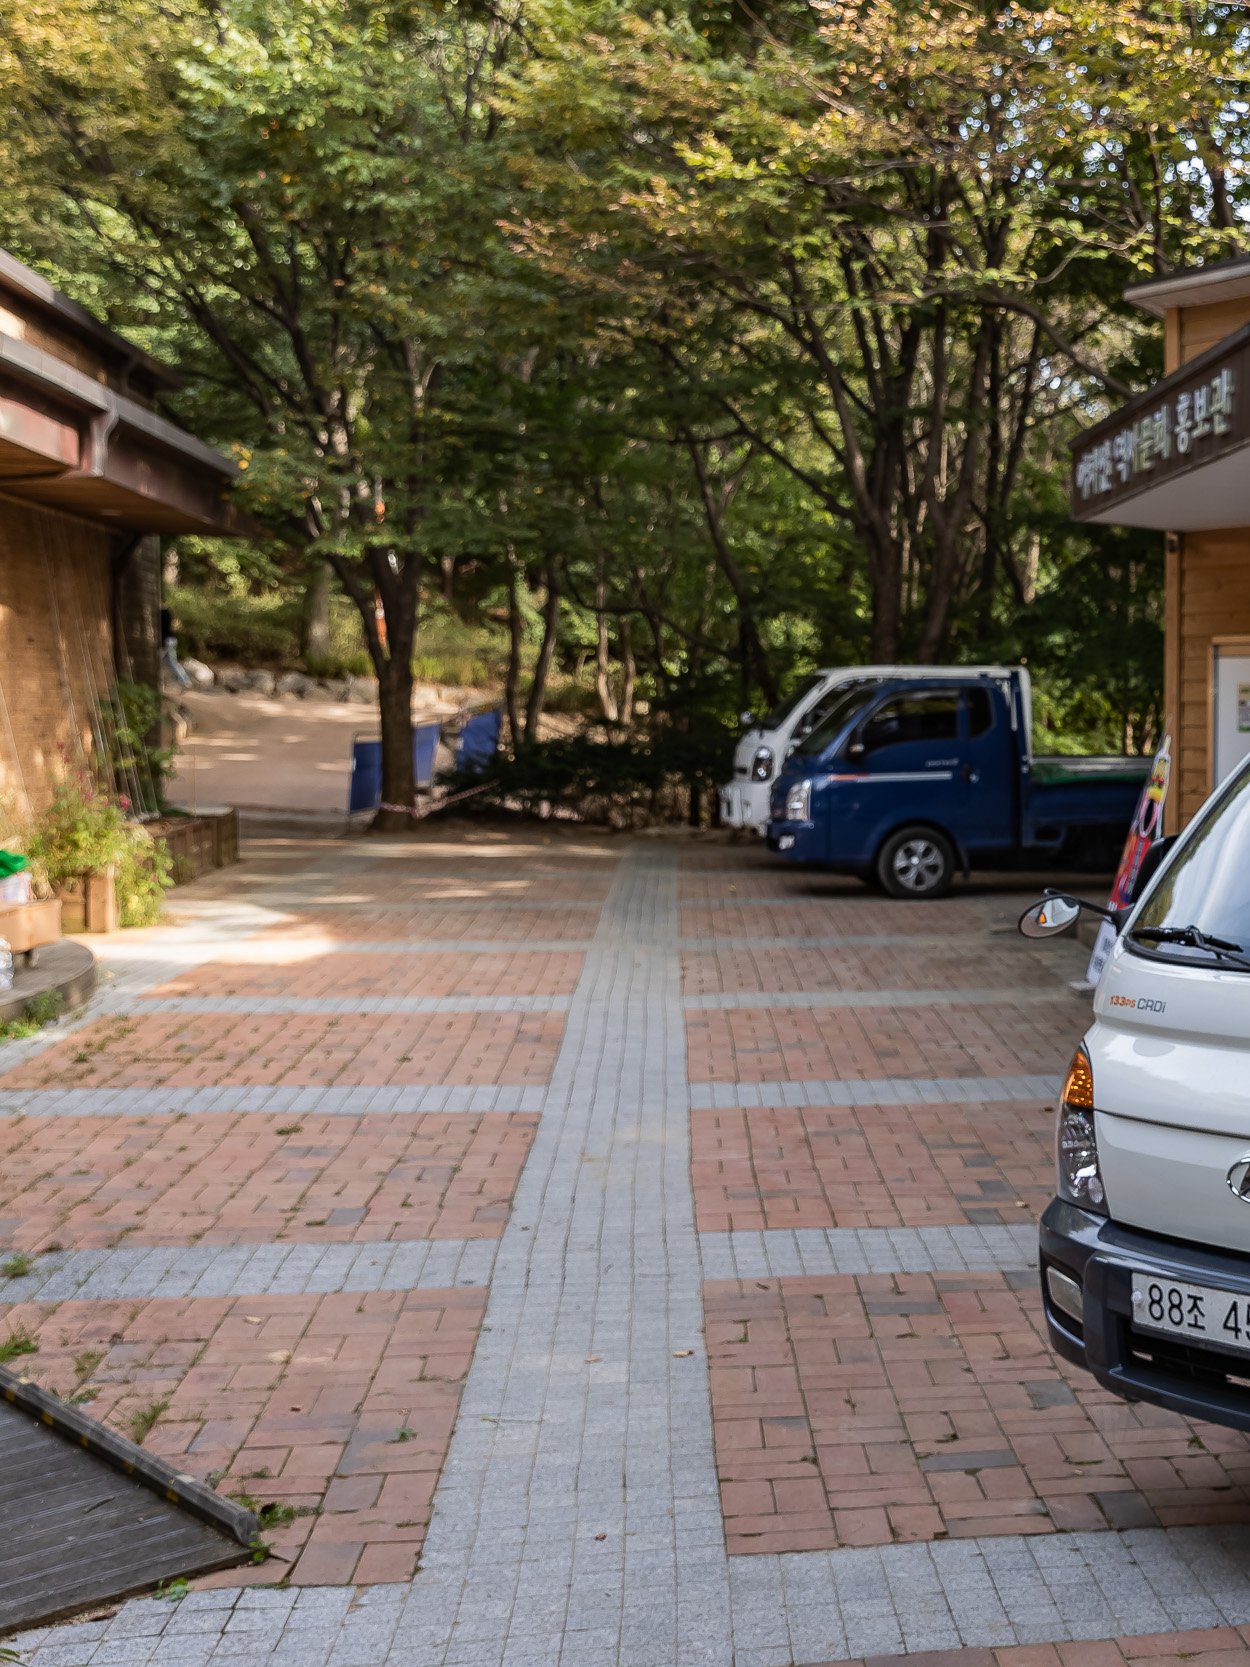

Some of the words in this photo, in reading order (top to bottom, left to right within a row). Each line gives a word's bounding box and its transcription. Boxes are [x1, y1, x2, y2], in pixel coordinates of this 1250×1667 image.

[1174, 367, 1235, 455] 홍보관
[1137, 998, 1167, 1013] CRDi
[1148, 1283, 1206, 1330] 88조
